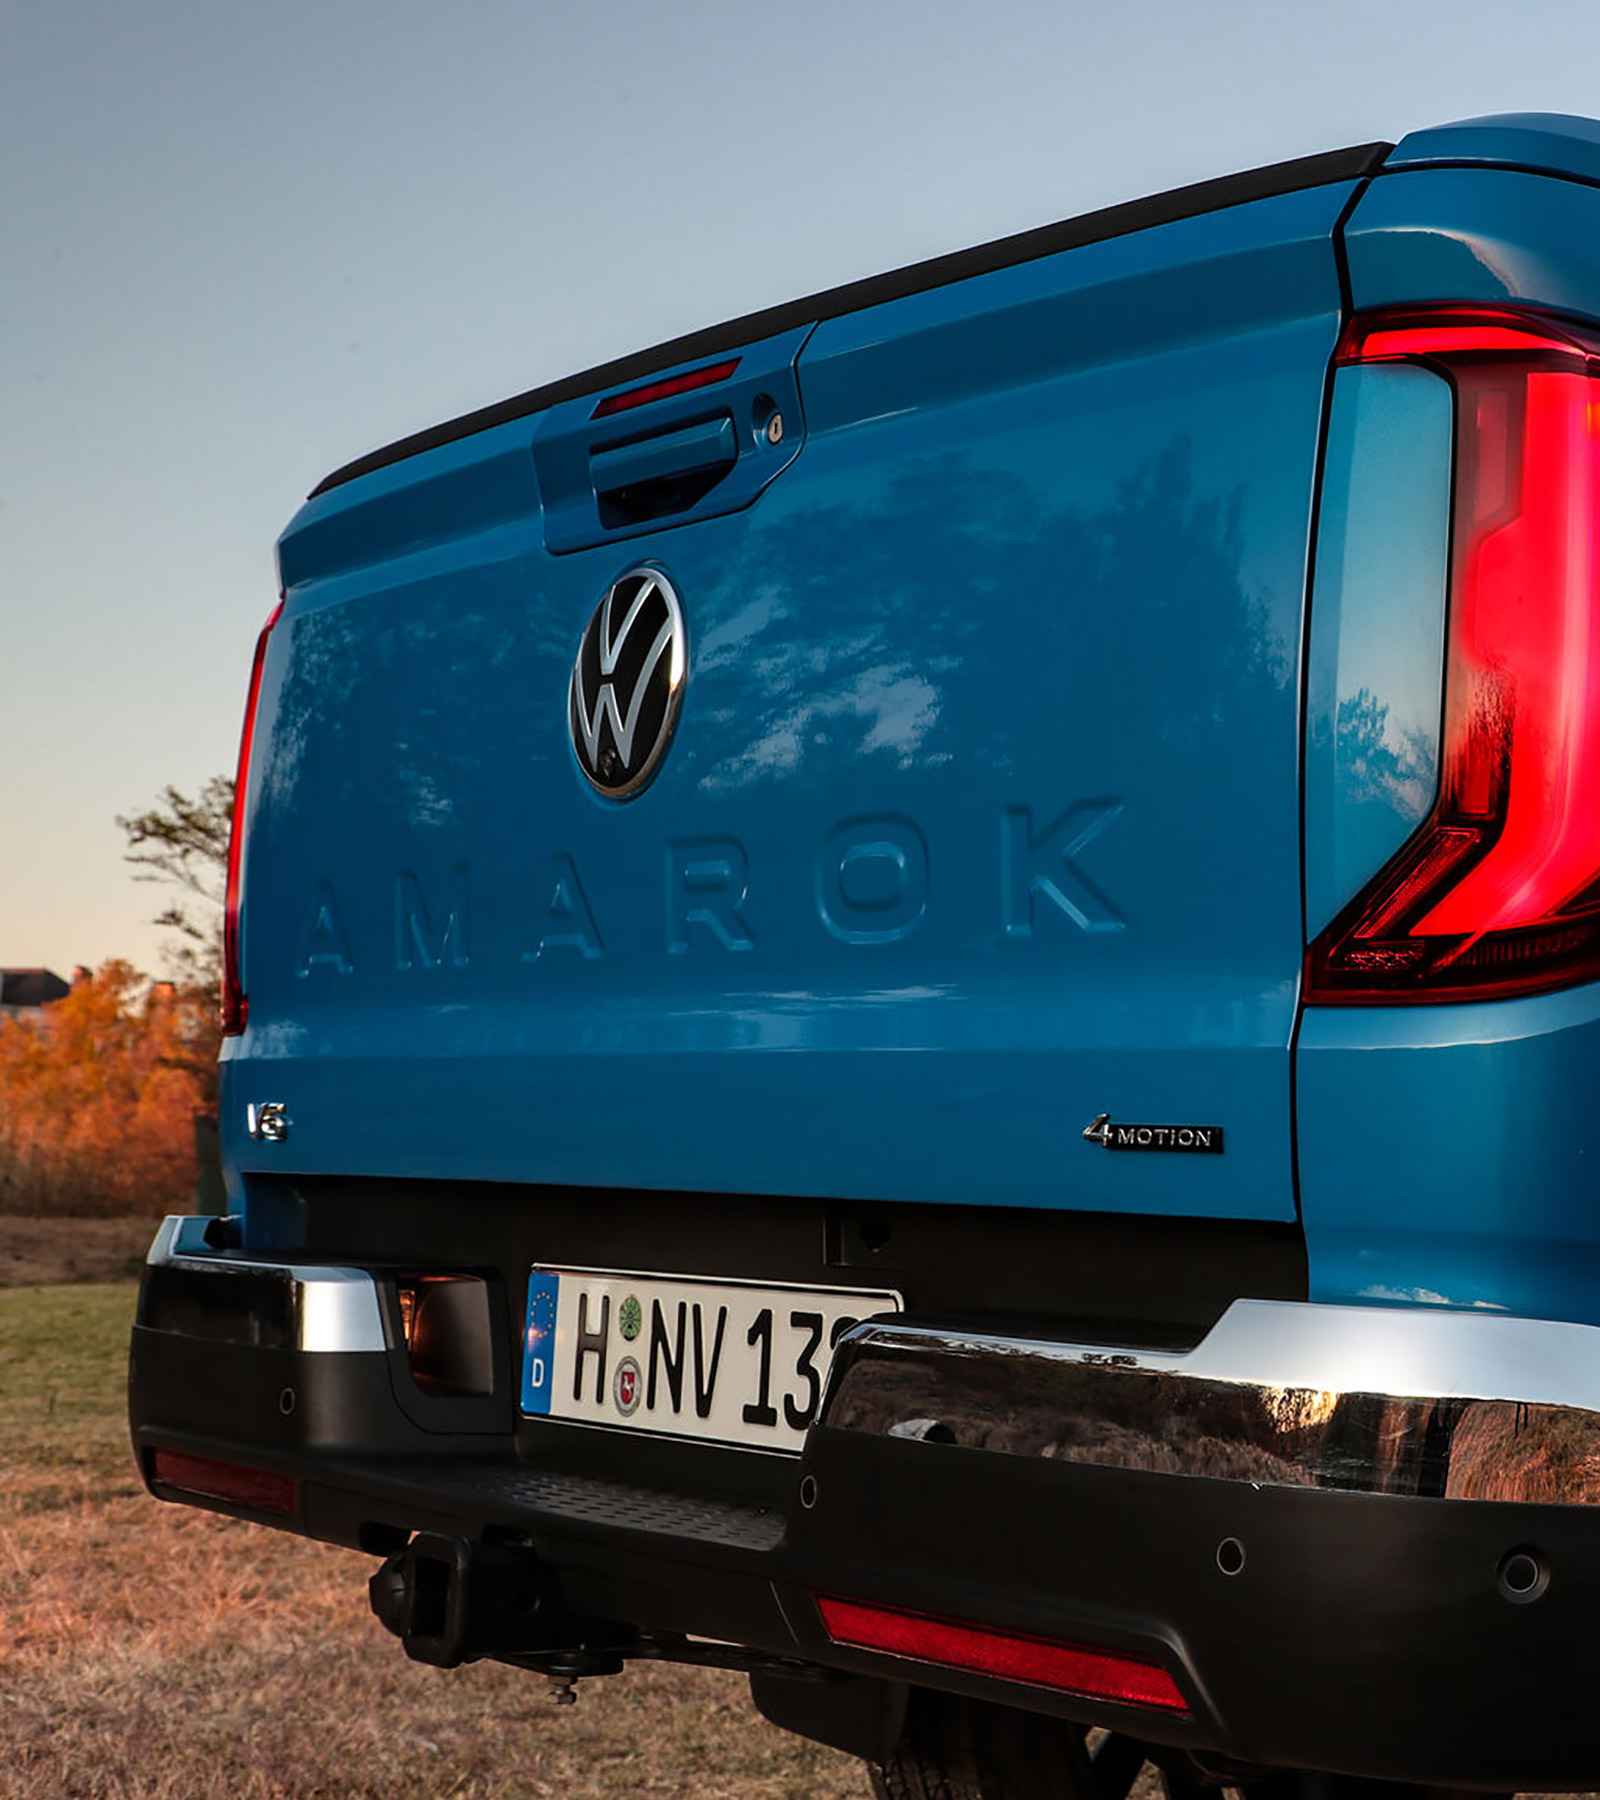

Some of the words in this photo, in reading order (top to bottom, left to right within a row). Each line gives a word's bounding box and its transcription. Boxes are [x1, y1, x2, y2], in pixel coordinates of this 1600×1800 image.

[298, 798, 1128, 979] AMAROK
[1082, 1112, 1211, 1146] 4MOTION
[532, 1358, 545, 1387] D
[573, 1293, 610, 1403] H
[646, 1299, 727, 1417] NV
[742, 1308, 860, 1431] 13
